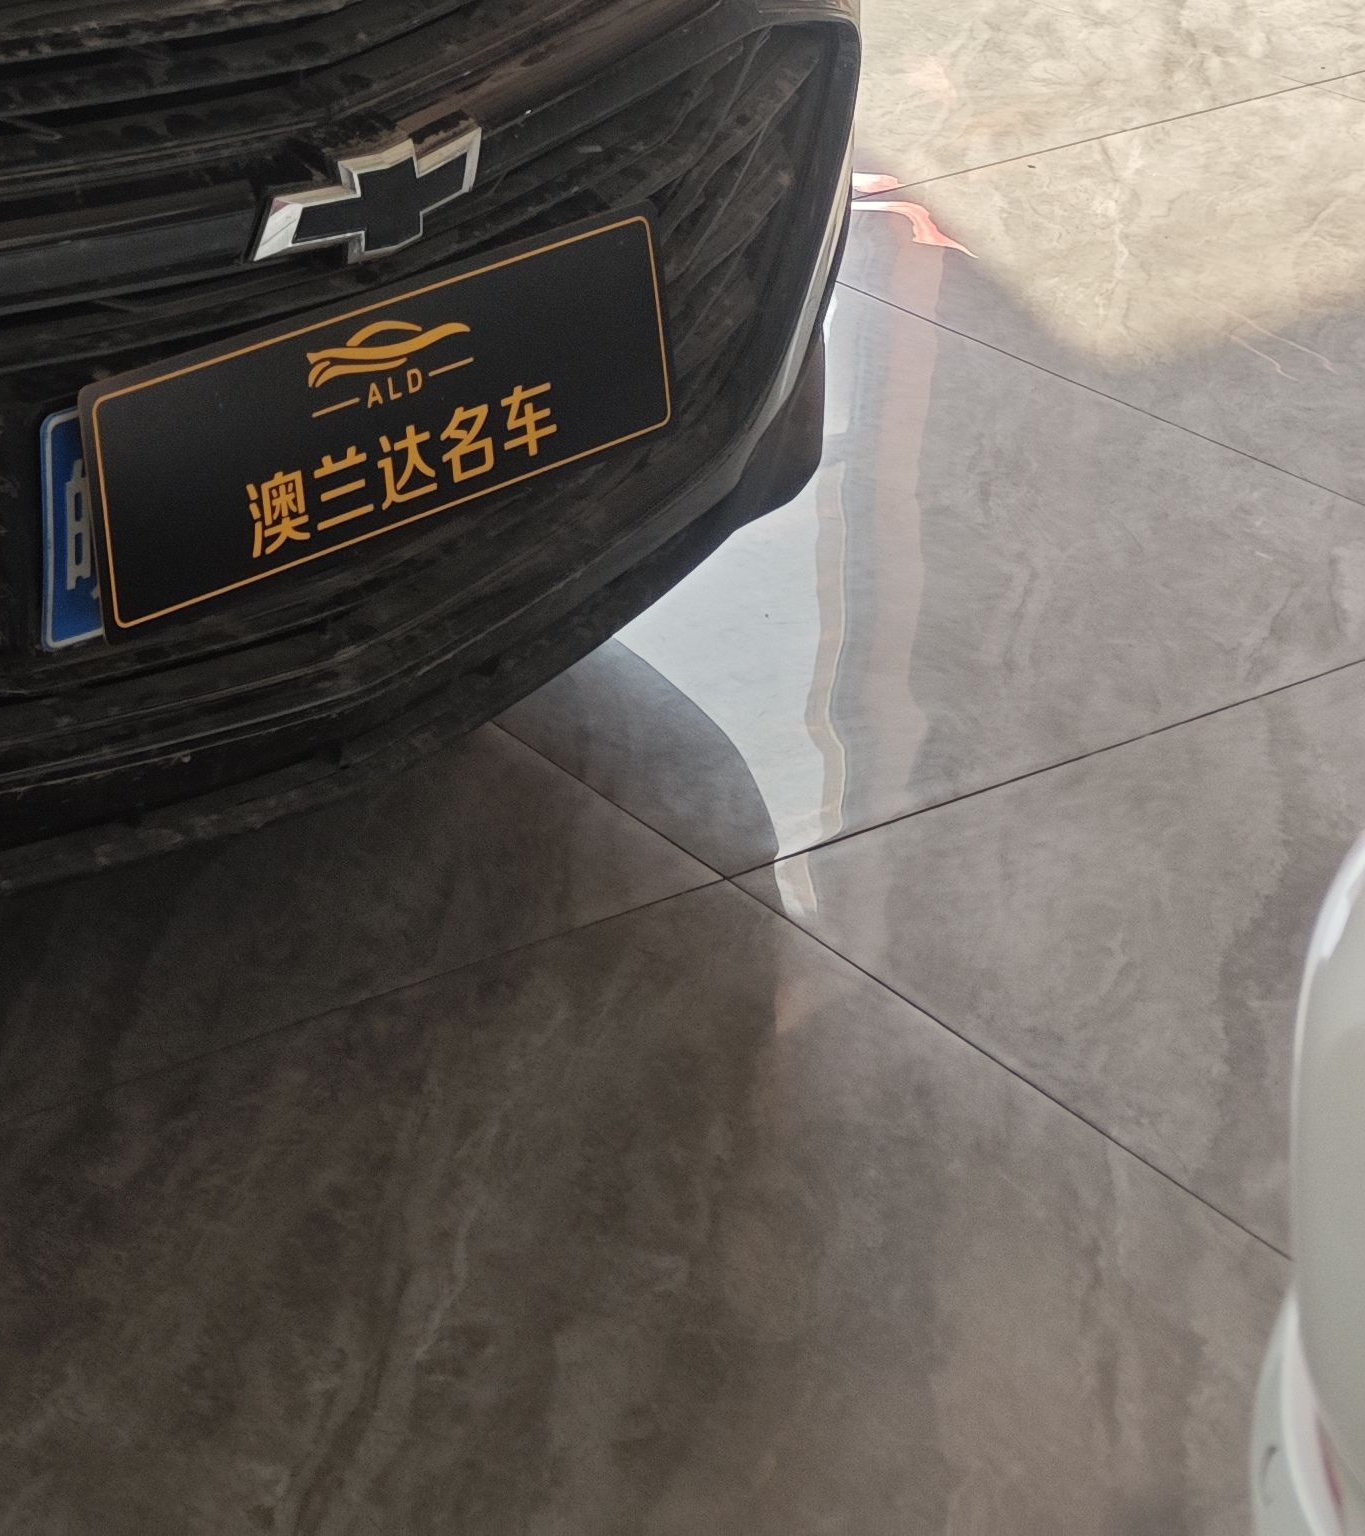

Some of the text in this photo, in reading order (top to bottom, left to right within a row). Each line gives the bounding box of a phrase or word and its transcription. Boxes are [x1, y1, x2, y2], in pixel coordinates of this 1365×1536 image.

[366, 368, 424, 410] ALD
[246, 381, 559, 559] 澳兰达名车
